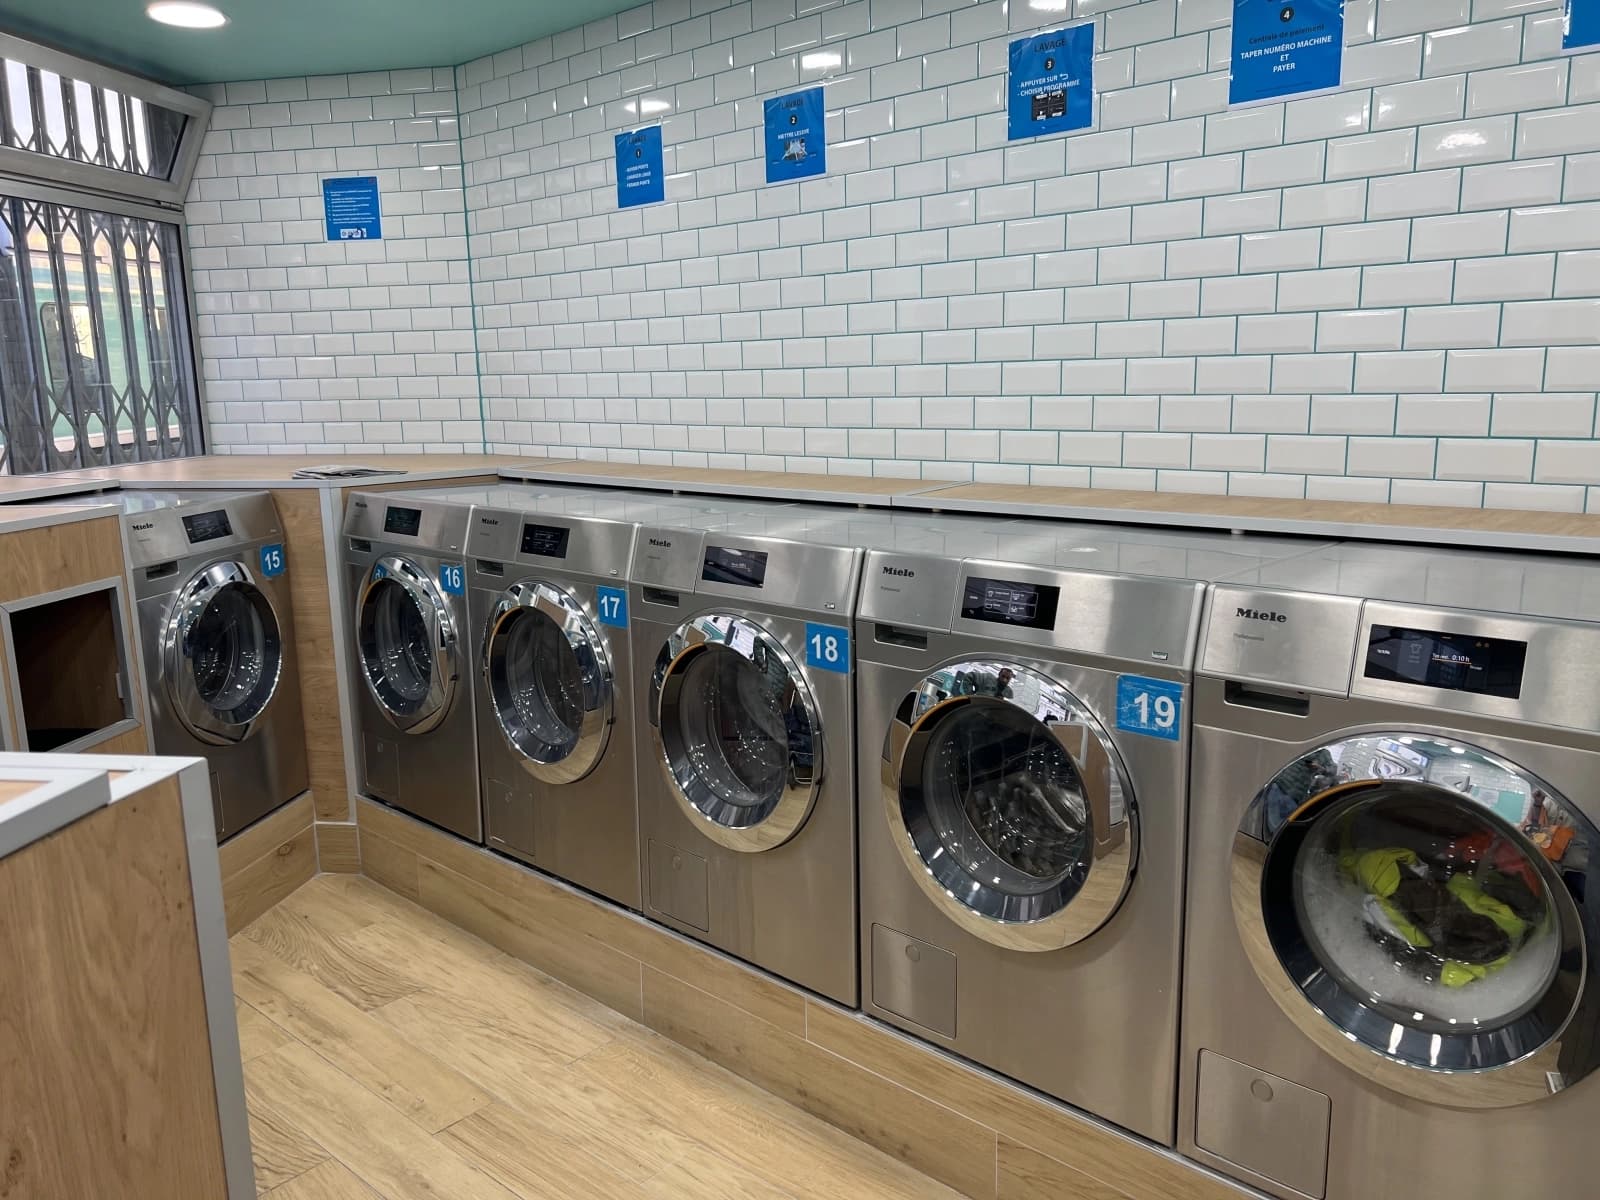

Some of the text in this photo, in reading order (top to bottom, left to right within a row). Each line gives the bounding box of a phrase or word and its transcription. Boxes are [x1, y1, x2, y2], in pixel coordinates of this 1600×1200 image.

[1034, 38, 1066, 52] LAVAGE
[1240, 35, 1333, 60] TAPER NUMÉRO MACHINE
[1280, 53, 1289, 62] ET
[1272, 62, 1296, 73] PAYER
[1020, 75, 1058, 88] APPUYER SUR
[1020, 86, 1043, 97] CHOISIR
[1043, 79, 1080, 92] PROGRAMME
[132, 522, 154, 531] Miele
[481, 517, 499, 526] Miele
[649, 538, 672, 548] Miele
[264, 551, 281, 571] 15
[444, 567, 461, 588] 16
[882, 566, 915, 578] Miele
[600, 595, 621, 618] 17
[1236, 607, 1287, 623] Miele
[811, 633, 839, 662] 18
[1134, 692, 1175, 728] 19
